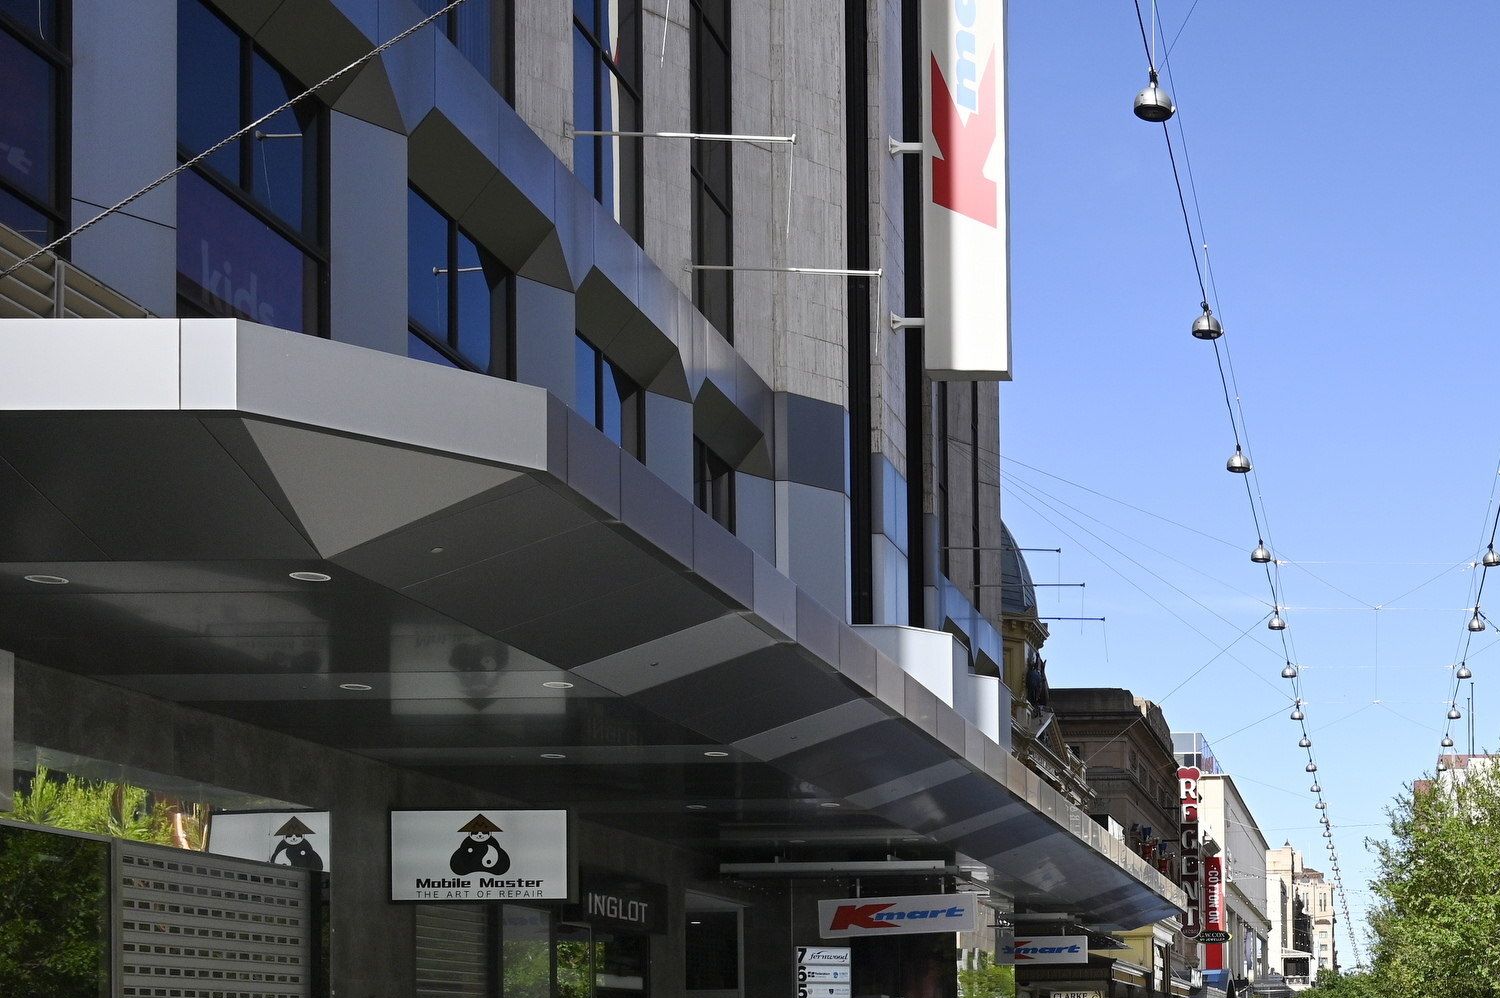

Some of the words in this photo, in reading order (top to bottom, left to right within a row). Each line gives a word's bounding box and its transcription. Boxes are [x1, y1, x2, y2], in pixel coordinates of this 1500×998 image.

[1180, 779, 1198, 926] REGENT
[416, 878, 471, 888] Mobile
[480, 878, 544, 888] Master
[1208, 870, 1219, 909] COTTON
[416, 890, 439, 898] THE
[446, 890, 469, 898] ART
[477, 890, 492, 898] OF
[500, 890, 543, 898] REPAIR
[588, 892, 648, 924] INGLOT
[830, 902, 965, 930] Kmart
[1208, 910, 1219, 924] ON
[798, 947, 807, 964] 7
[808, 950, 849, 963] fernwood
[798, 966, 807, 982] 6
